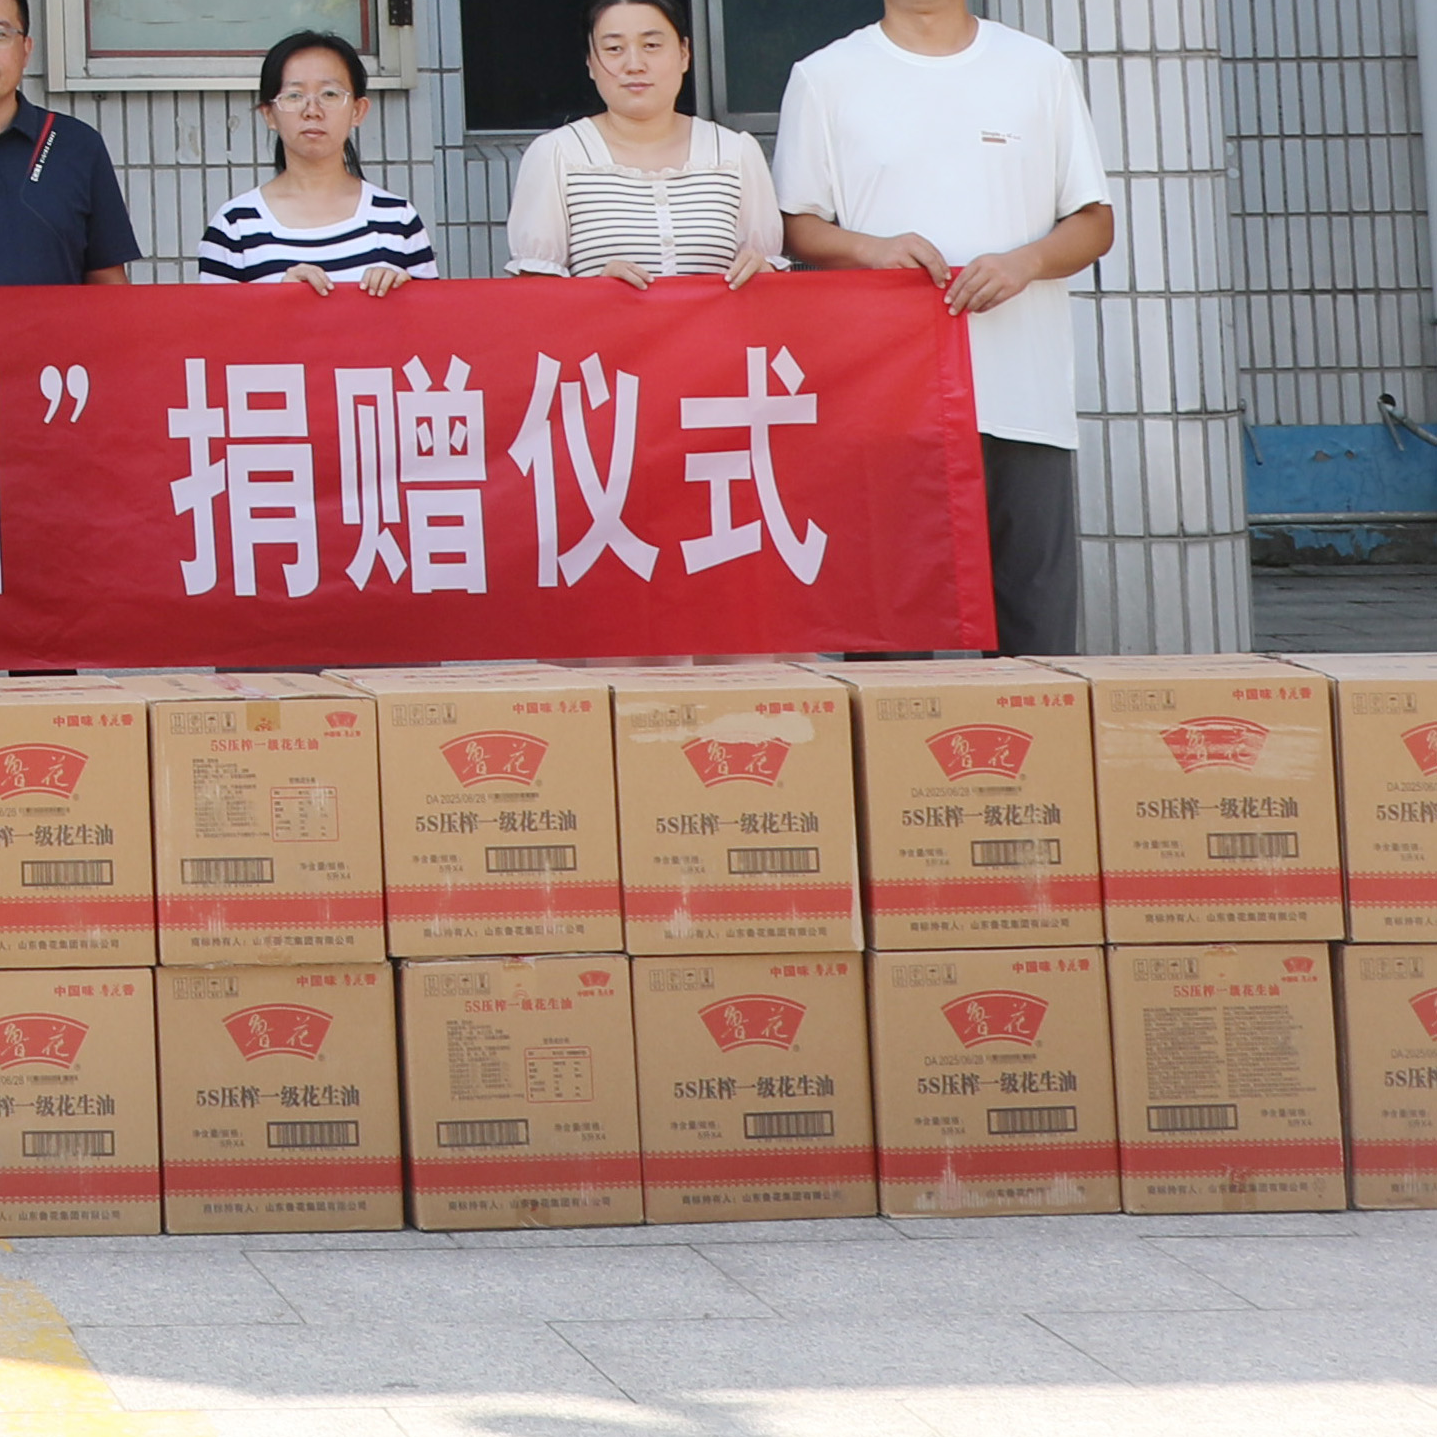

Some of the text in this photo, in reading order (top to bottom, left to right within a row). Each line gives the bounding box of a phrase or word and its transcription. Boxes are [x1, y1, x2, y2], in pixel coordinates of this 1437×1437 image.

[996, 695, 1037, 707] 中国味
[1232, 688, 1272, 700] 中国味
[513, 702, 553, 714] 中国味
[755, 702, 795, 714] 中国味
[54, 715, 93, 726] 中国味
[210, 738, 320, 752] 5S压榨一级花生油
[901, 805, 1061, 826] 5S压榨一级花生油
[1135, 798, 1298, 820] 5S压榨一级花生油
[414, 811, 577, 833] 5S压榨一级花生油
[655, 813, 820, 835] 5S压榨一级花生油
[770, 965, 810, 977] 中国味
[1012, 961, 1052, 973] 中国味
[297, 975, 336, 986] 中国味
[55, 985, 94, 996] 中国味
[1173, 983, 1281, 999] 5S压榨一级花生油
[464, 996, 573, 1014] 5S压榨一级花生油
[673, 1077, 835, 1099] 5S压榨一级花生油
[916, 1073, 1078, 1095] 5S压榨一级花生油
[195, 1086, 360, 1108] 5S压榨一级花生油
